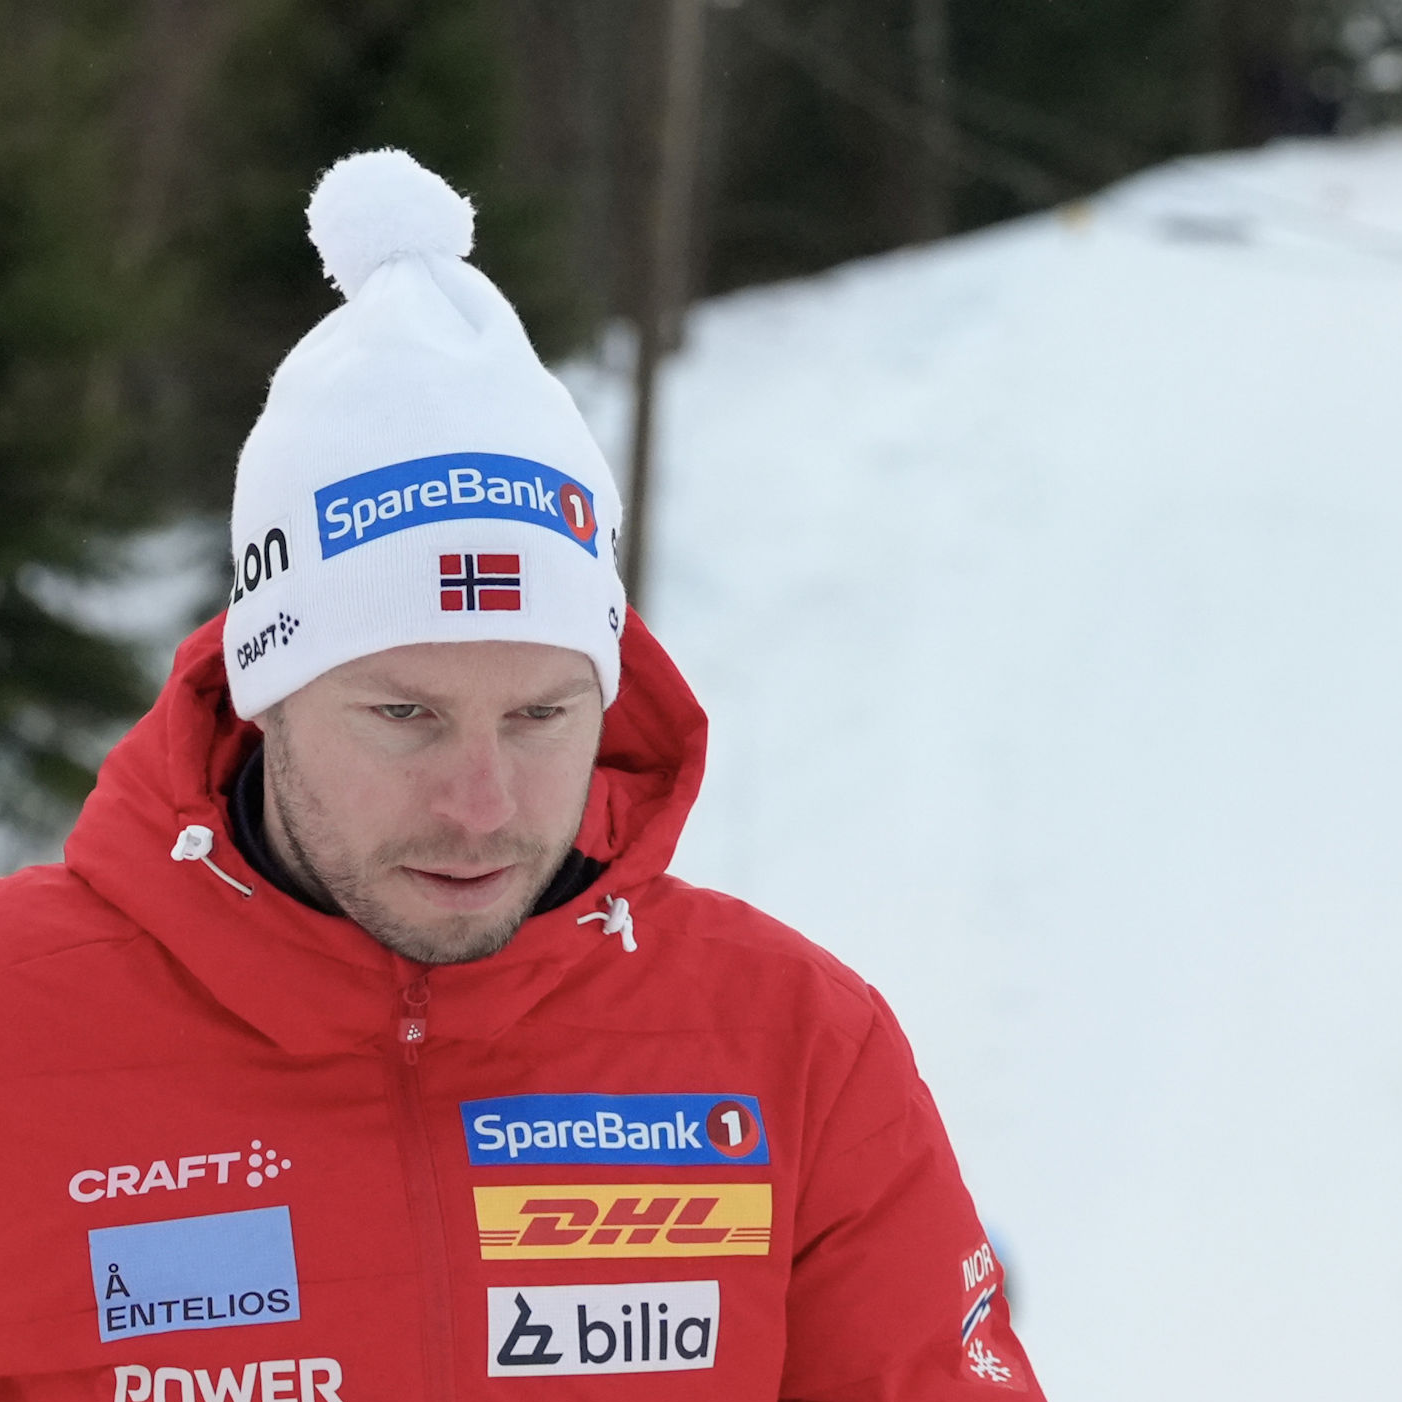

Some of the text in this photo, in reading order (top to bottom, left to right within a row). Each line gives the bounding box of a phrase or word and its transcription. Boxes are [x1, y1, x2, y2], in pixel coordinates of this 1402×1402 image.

[324, 468, 587, 540] SpareBank 1
[236, 623, 277, 671] CRAFT
[473, 1110, 743, 1159] SpareBank 1
[68, 1151, 241, 1203] CRAFT
[516, 1197, 735, 1246] DHL
[105, 1263, 131, 1300] Å
[962, 1242, 995, 1292] NOR
[106, 1288, 291, 1332] ENTELIOS
[576, 1301, 712, 1365] bilia
